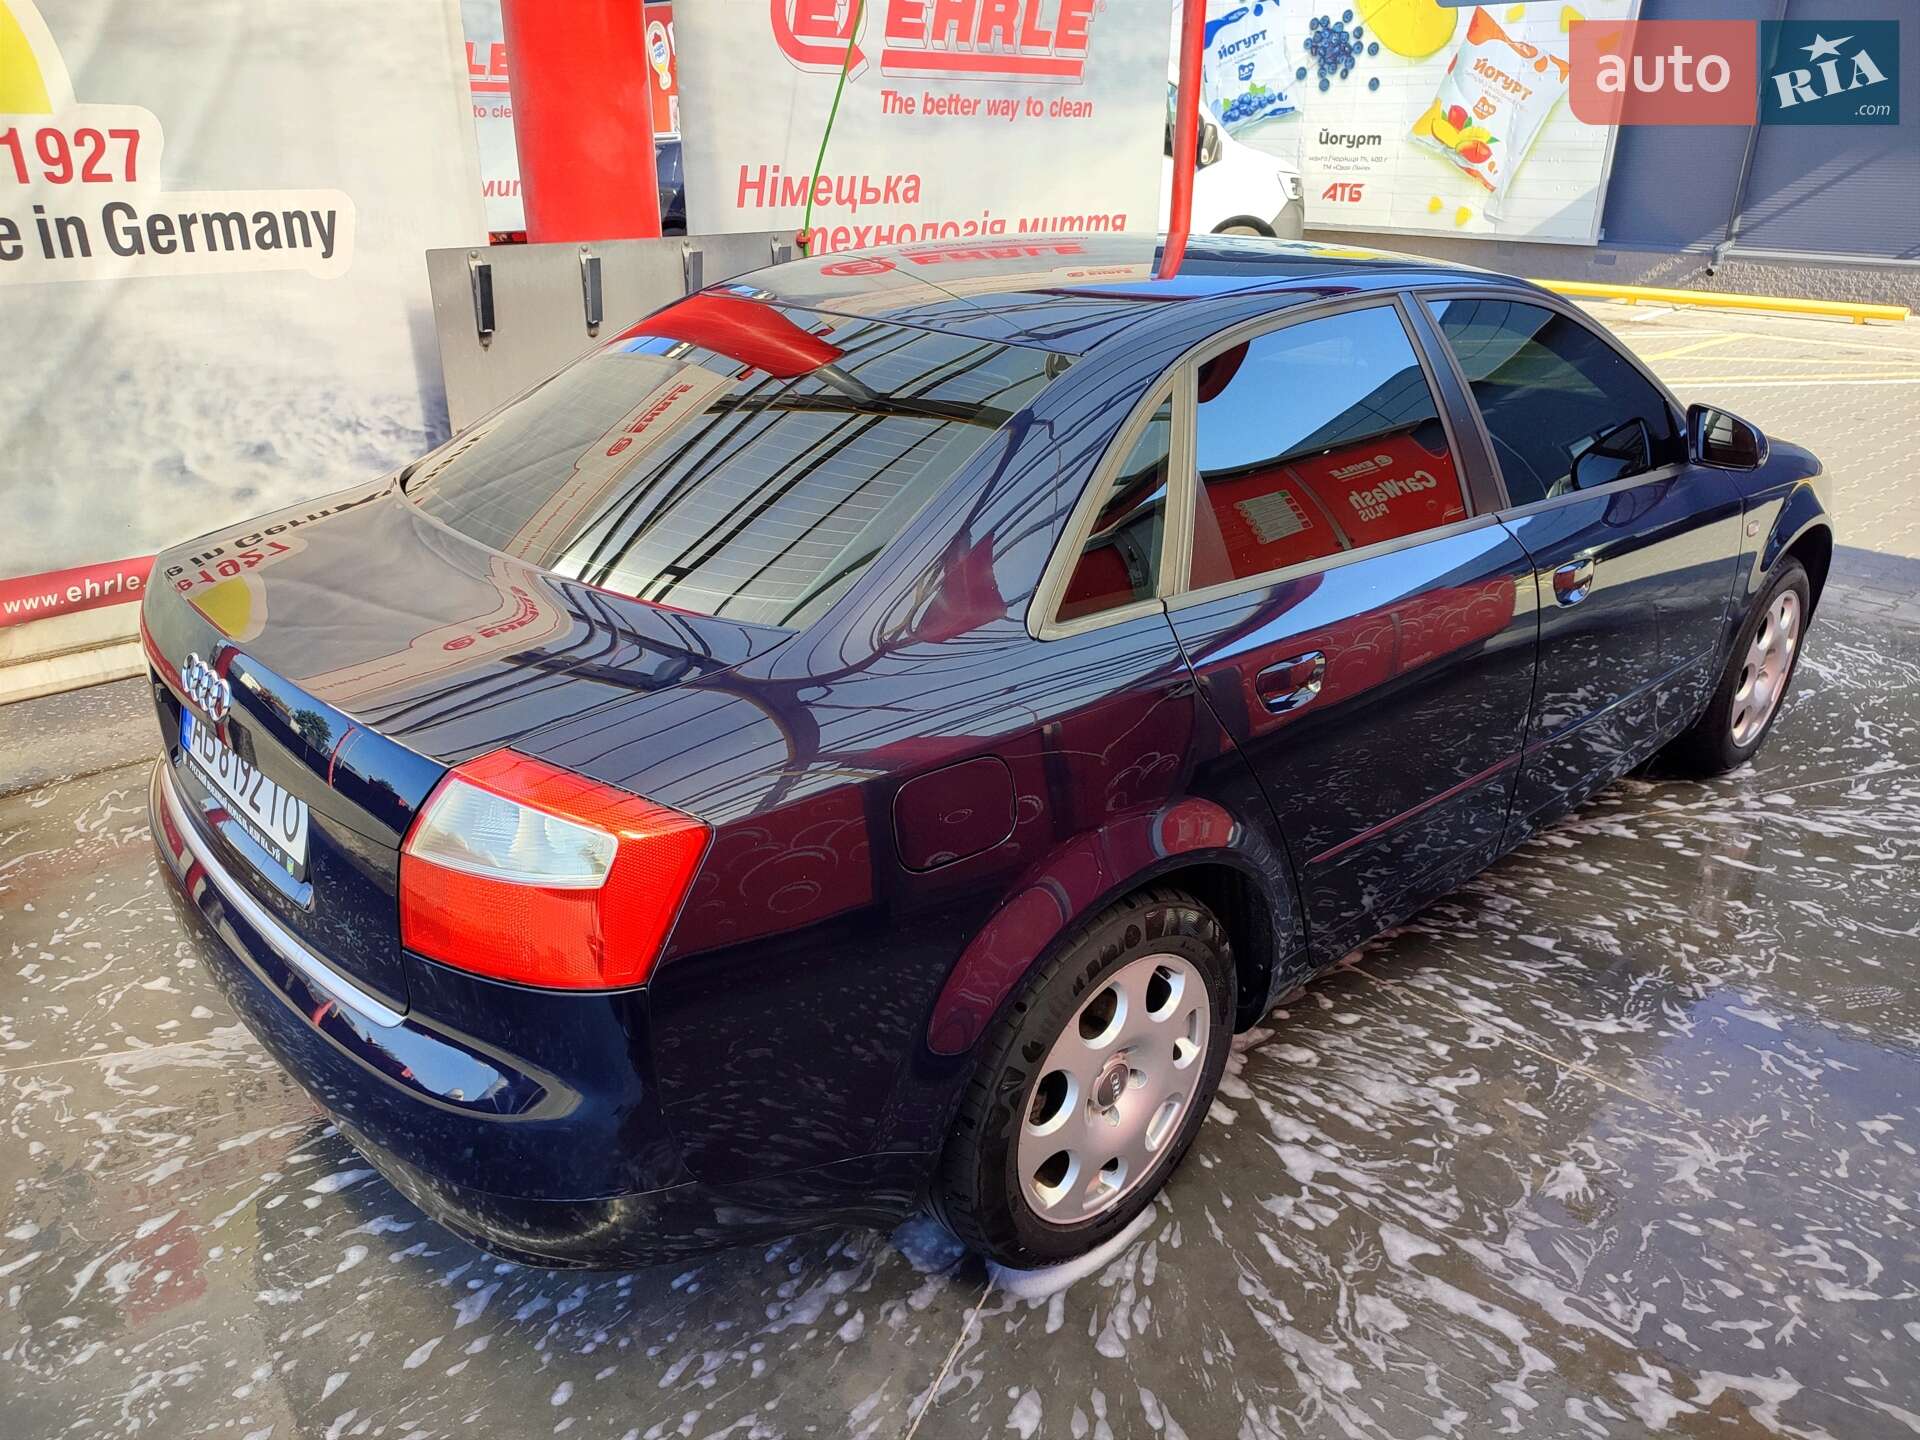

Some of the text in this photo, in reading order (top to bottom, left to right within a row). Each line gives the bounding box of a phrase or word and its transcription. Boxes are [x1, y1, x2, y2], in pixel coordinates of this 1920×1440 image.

[881, 90, 1093, 122] The better way to clean
[0, 127, 140, 185] 1927
[736, 164, 921, 214] Німецька
[33, 204, 93, 260] in
[102, 201, 337, 259] Germany
